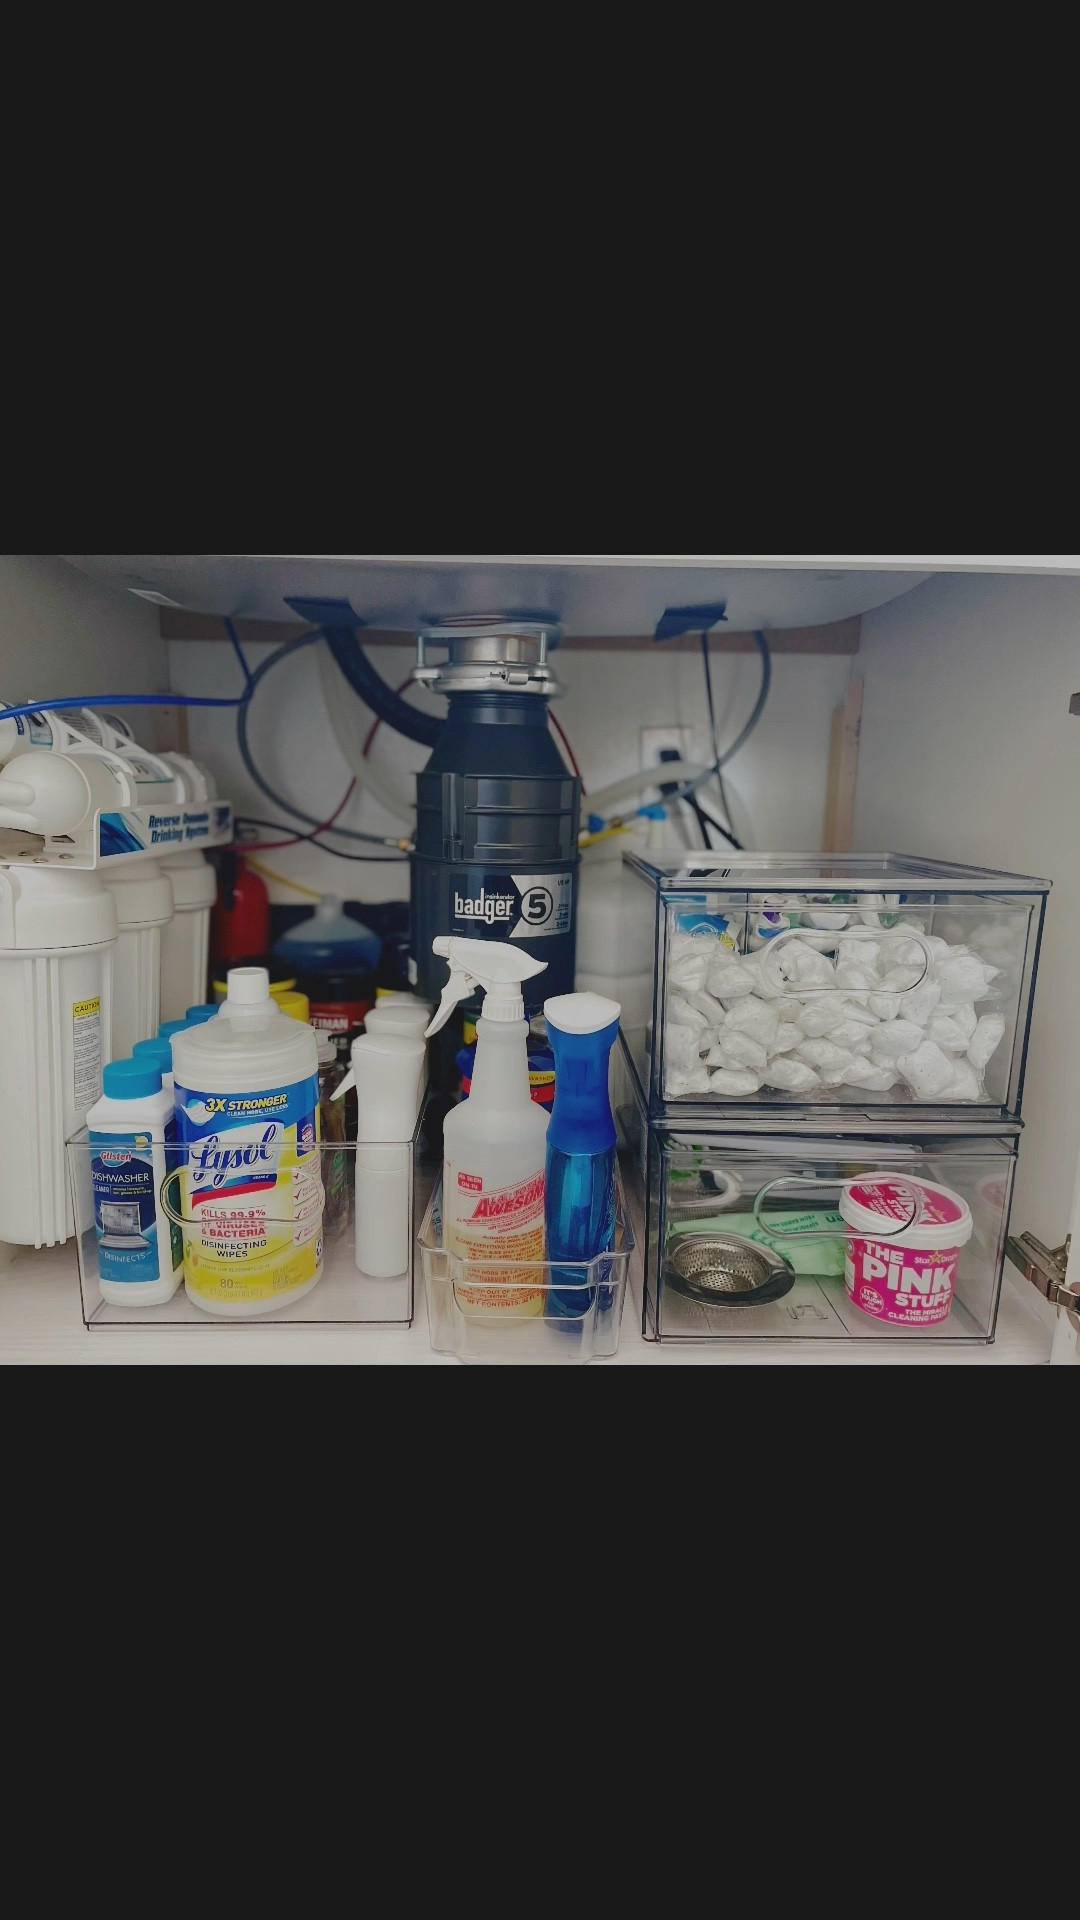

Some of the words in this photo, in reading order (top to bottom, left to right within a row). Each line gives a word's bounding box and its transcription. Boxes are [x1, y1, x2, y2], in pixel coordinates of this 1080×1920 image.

[149, 815, 180, 828] Reverse
[151, 830, 183, 843] Drinking
[455, 888, 514, 924] badger
[528, 894, 547, 919] 5
[311, 1017, 349, 1029] EIMAN
[205, 1097, 228, 1112] 3X
[228, 1093, 288, 1111] STRONGER
[101, 1150, 132, 1162] Glisten
[190, 1124, 277, 1187] Lysol
[92, 1171, 149, 1183] DISHWASHER
[94, 1184, 109, 1193] LEANER
[201, 1208, 227, 1219] KILLS
[230, 1209, 266, 1218] 99.9%
[209, 1227, 266, 1238] BACTERIA
[201, 1239, 267, 1249] DISINFECTING
[104, 1251, 146, 1263] DISINFECTS
[863, 1241, 905, 1266] THE
[914, 1256, 931, 1265] Star
[862, 1252, 955, 1295] PINK
[220, 1278, 234, 1289] 80
[895, 1289, 952, 1308] STUFF
[888, 1311, 929, 1322] CLEANING
[905, 1308, 922, 1316] THE
